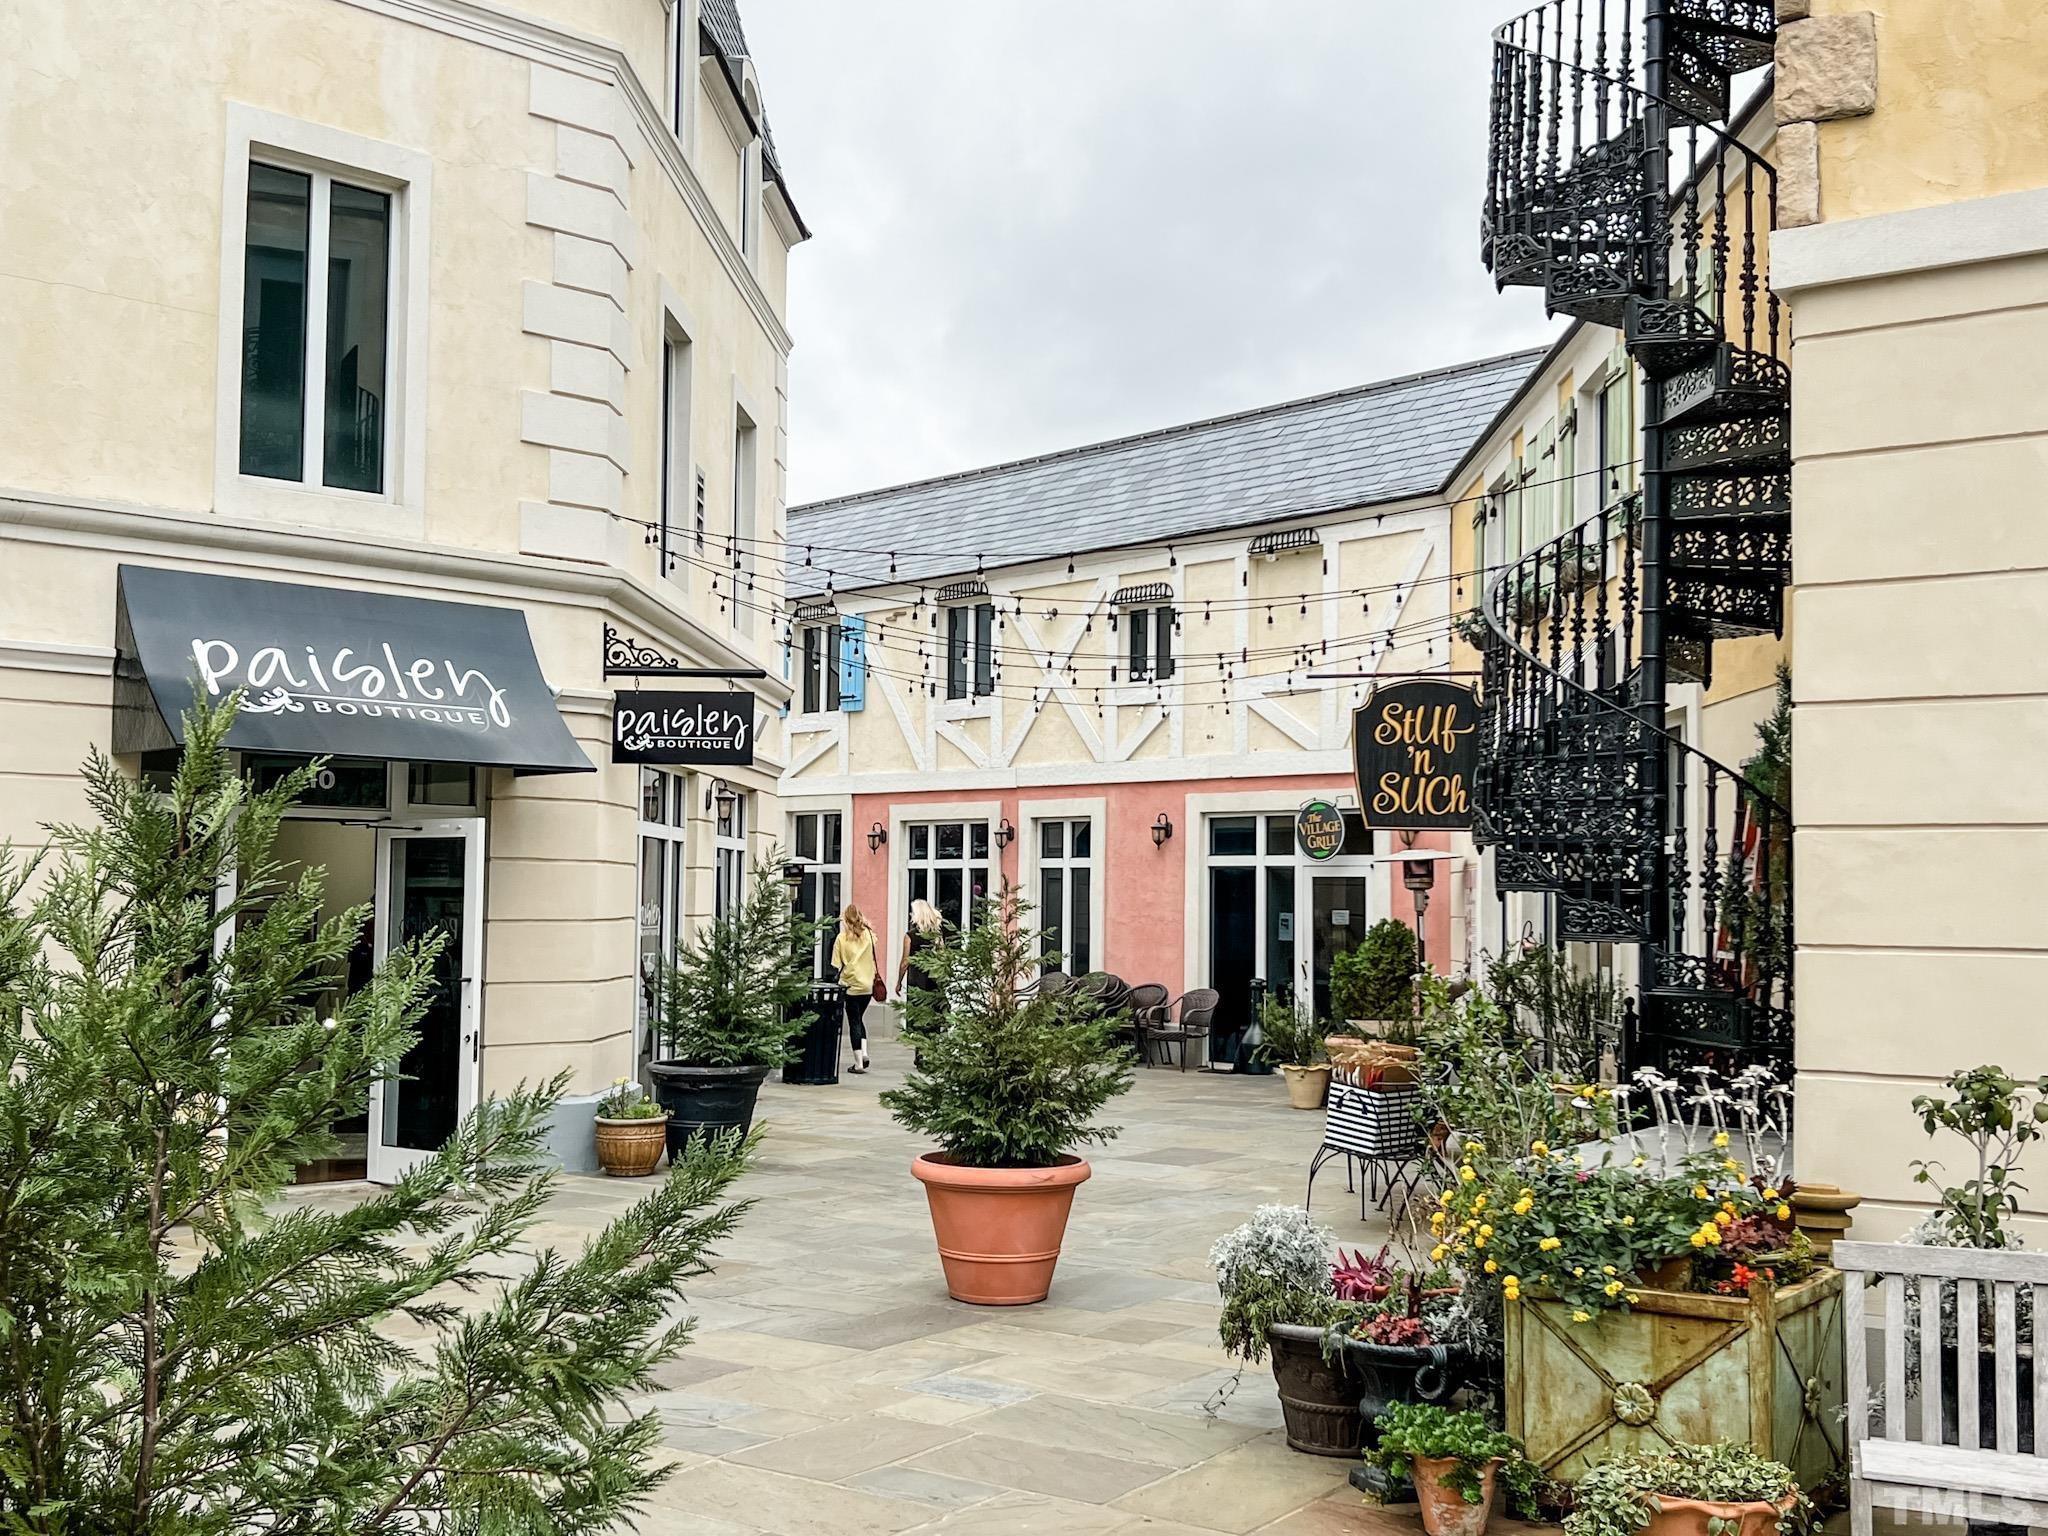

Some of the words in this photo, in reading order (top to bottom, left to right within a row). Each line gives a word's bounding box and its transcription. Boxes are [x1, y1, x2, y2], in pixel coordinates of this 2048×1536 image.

[192, 638, 511, 728] paisley
[313, 701, 486, 725] BOUTIQUE
[617, 703, 749, 750] paisley
[657, 740, 731, 750] BOUTIQUE
[1406, 745, 1435, 775] 'n
[1298, 819, 1342, 836] VILLAGE
[1307, 812, 1323, 824] The
[1307, 834, 1339, 850] GRILL
